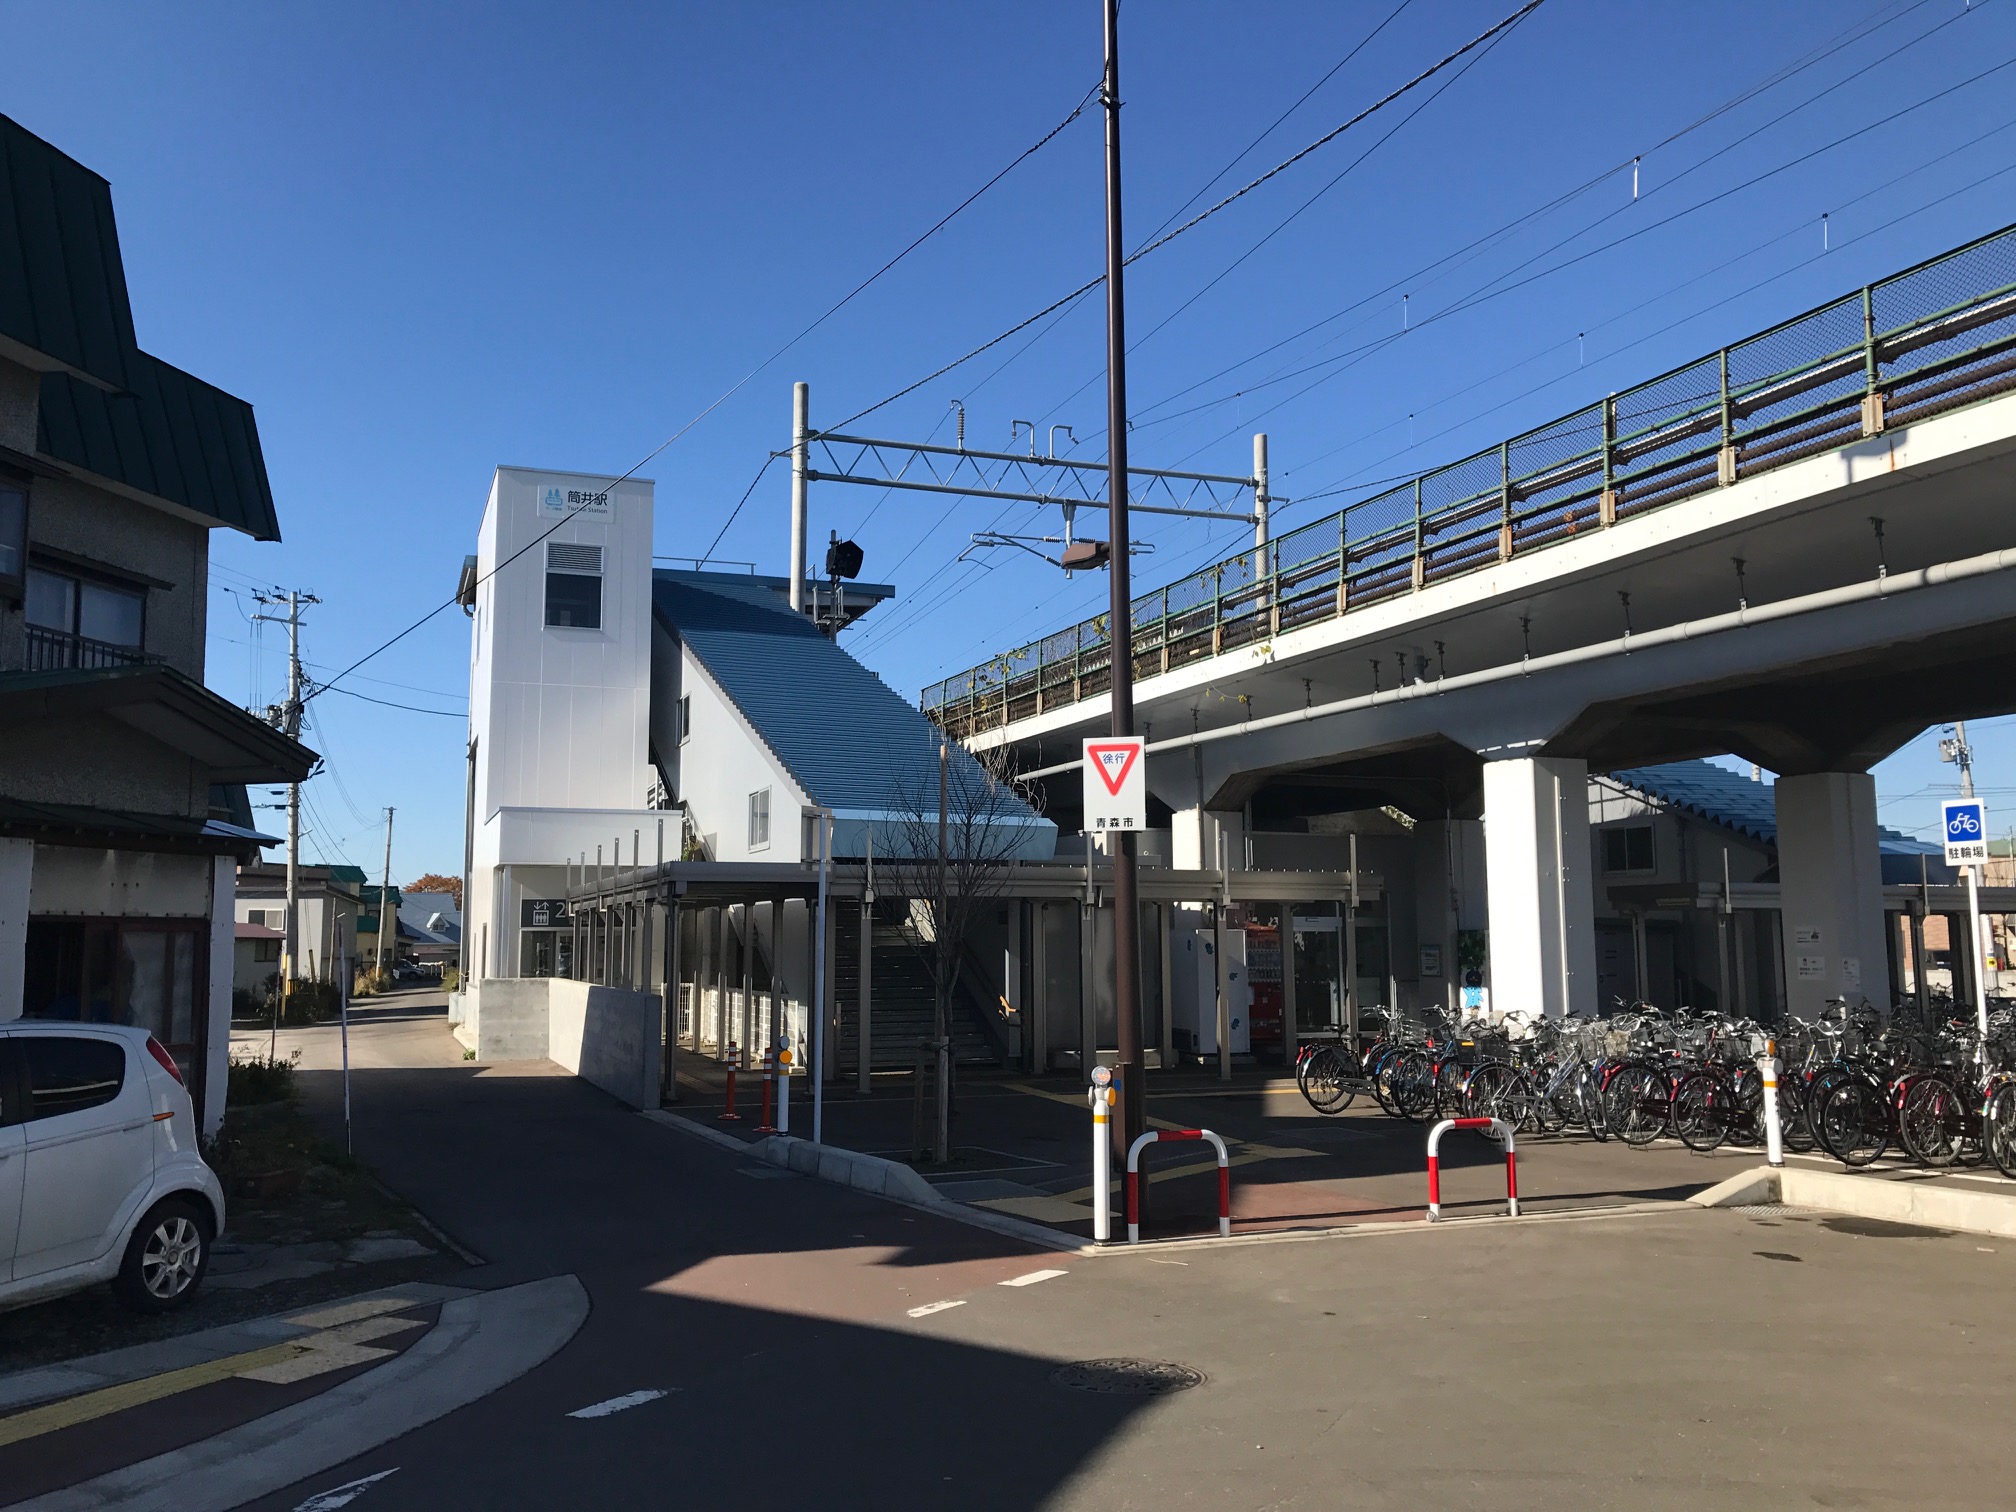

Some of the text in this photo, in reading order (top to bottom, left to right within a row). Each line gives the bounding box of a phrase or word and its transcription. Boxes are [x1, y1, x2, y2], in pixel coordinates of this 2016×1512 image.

[567, 490, 608, 507] 筒井駅
[1102, 752, 1126, 765] 徐行
[1096, 817, 1134, 829] 青森市
[1948, 846, 1984, 860] 駐輪場
